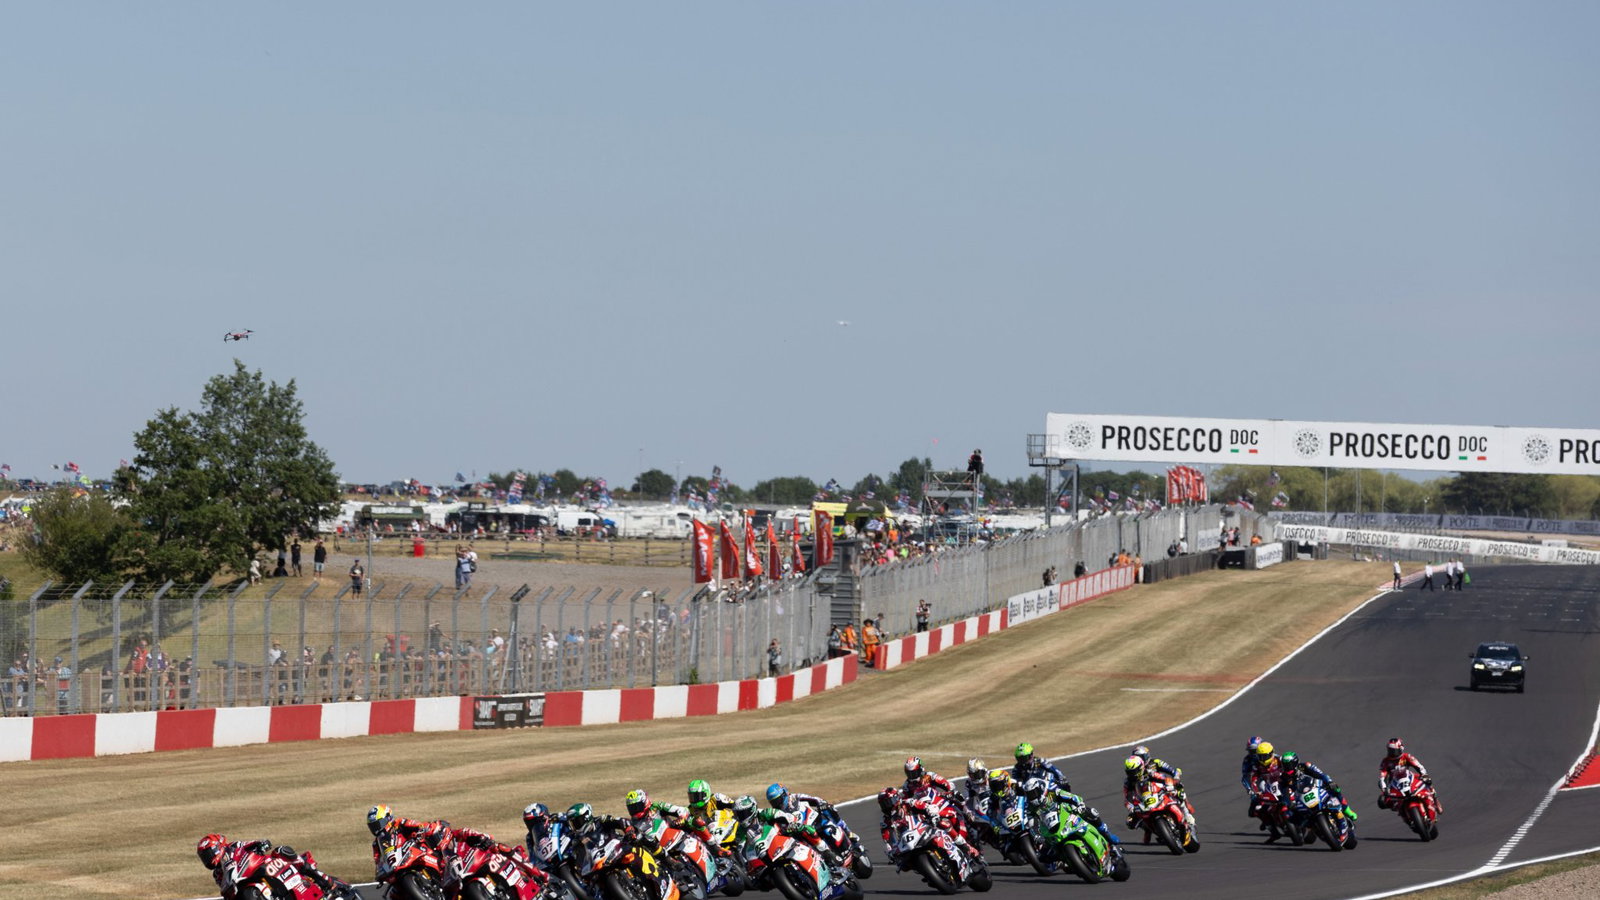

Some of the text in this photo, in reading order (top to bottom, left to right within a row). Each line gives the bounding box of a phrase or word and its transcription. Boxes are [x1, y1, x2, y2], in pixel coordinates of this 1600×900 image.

[1101, 425, 1258, 453] PROSECCO DOC
[1329, 432, 1487, 460] PROSECCO DOC
[1345, 532, 1388, 546] PROSECCO
[1417, 537, 1459, 551] PROSECCO
[1487, 543, 1528, 557] PROSECCO
[1556, 549, 1597, 565] PROSECCO
[1304, 792, 1316, 803] 62
[1006, 812, 1020, 826] 55
[541, 842, 553, 857] 97
